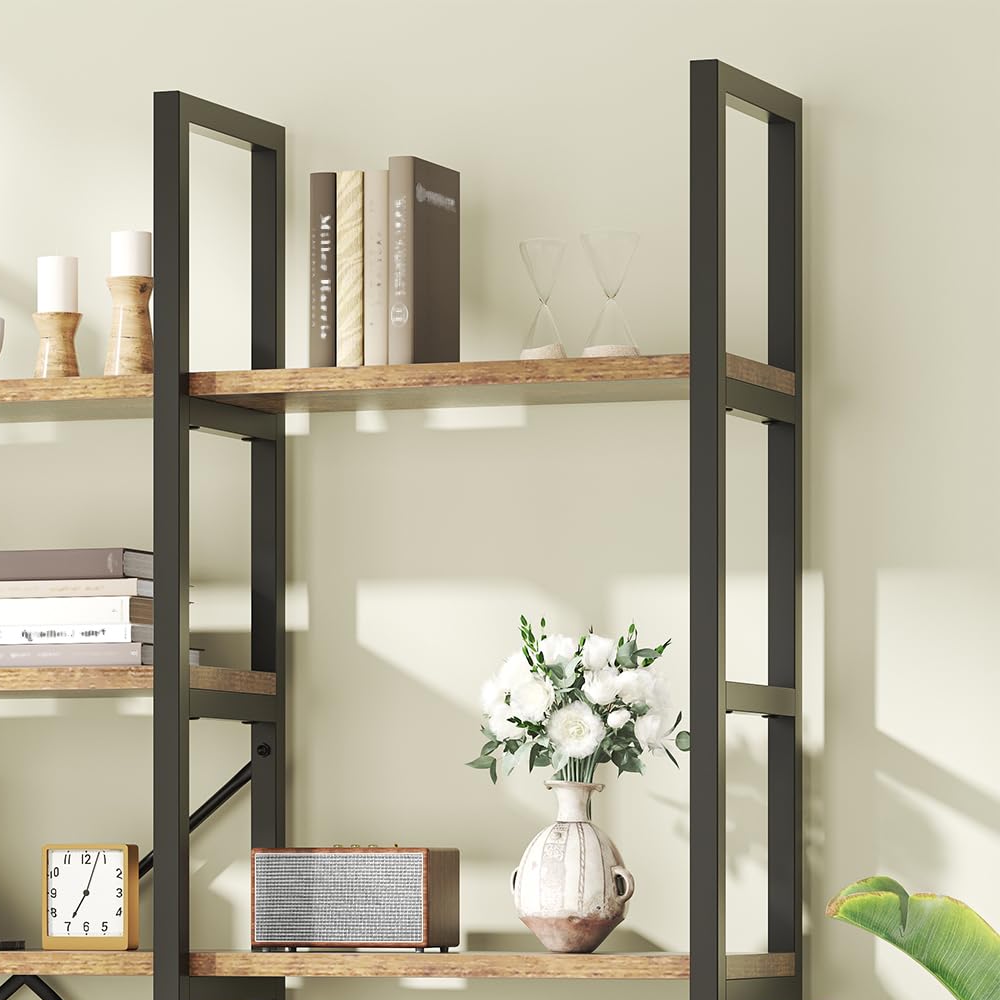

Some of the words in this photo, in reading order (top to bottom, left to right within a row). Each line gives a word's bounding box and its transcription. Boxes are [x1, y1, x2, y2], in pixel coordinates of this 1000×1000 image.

[63, 854, 71, 864] 11
[81, 854, 91, 864] 12
[49, 866, 60, 879] 10
[115, 868, 123, 879] 2
[50, 888, 57, 898] 9
[115, 888, 123, 898] 3
[50, 907, 57, 918] 8
[115, 907, 123, 916] 4
[64, 921, 71, 932] 7
[82, 921, 90, 932] 6
[101, 921, 108, 932] 5
